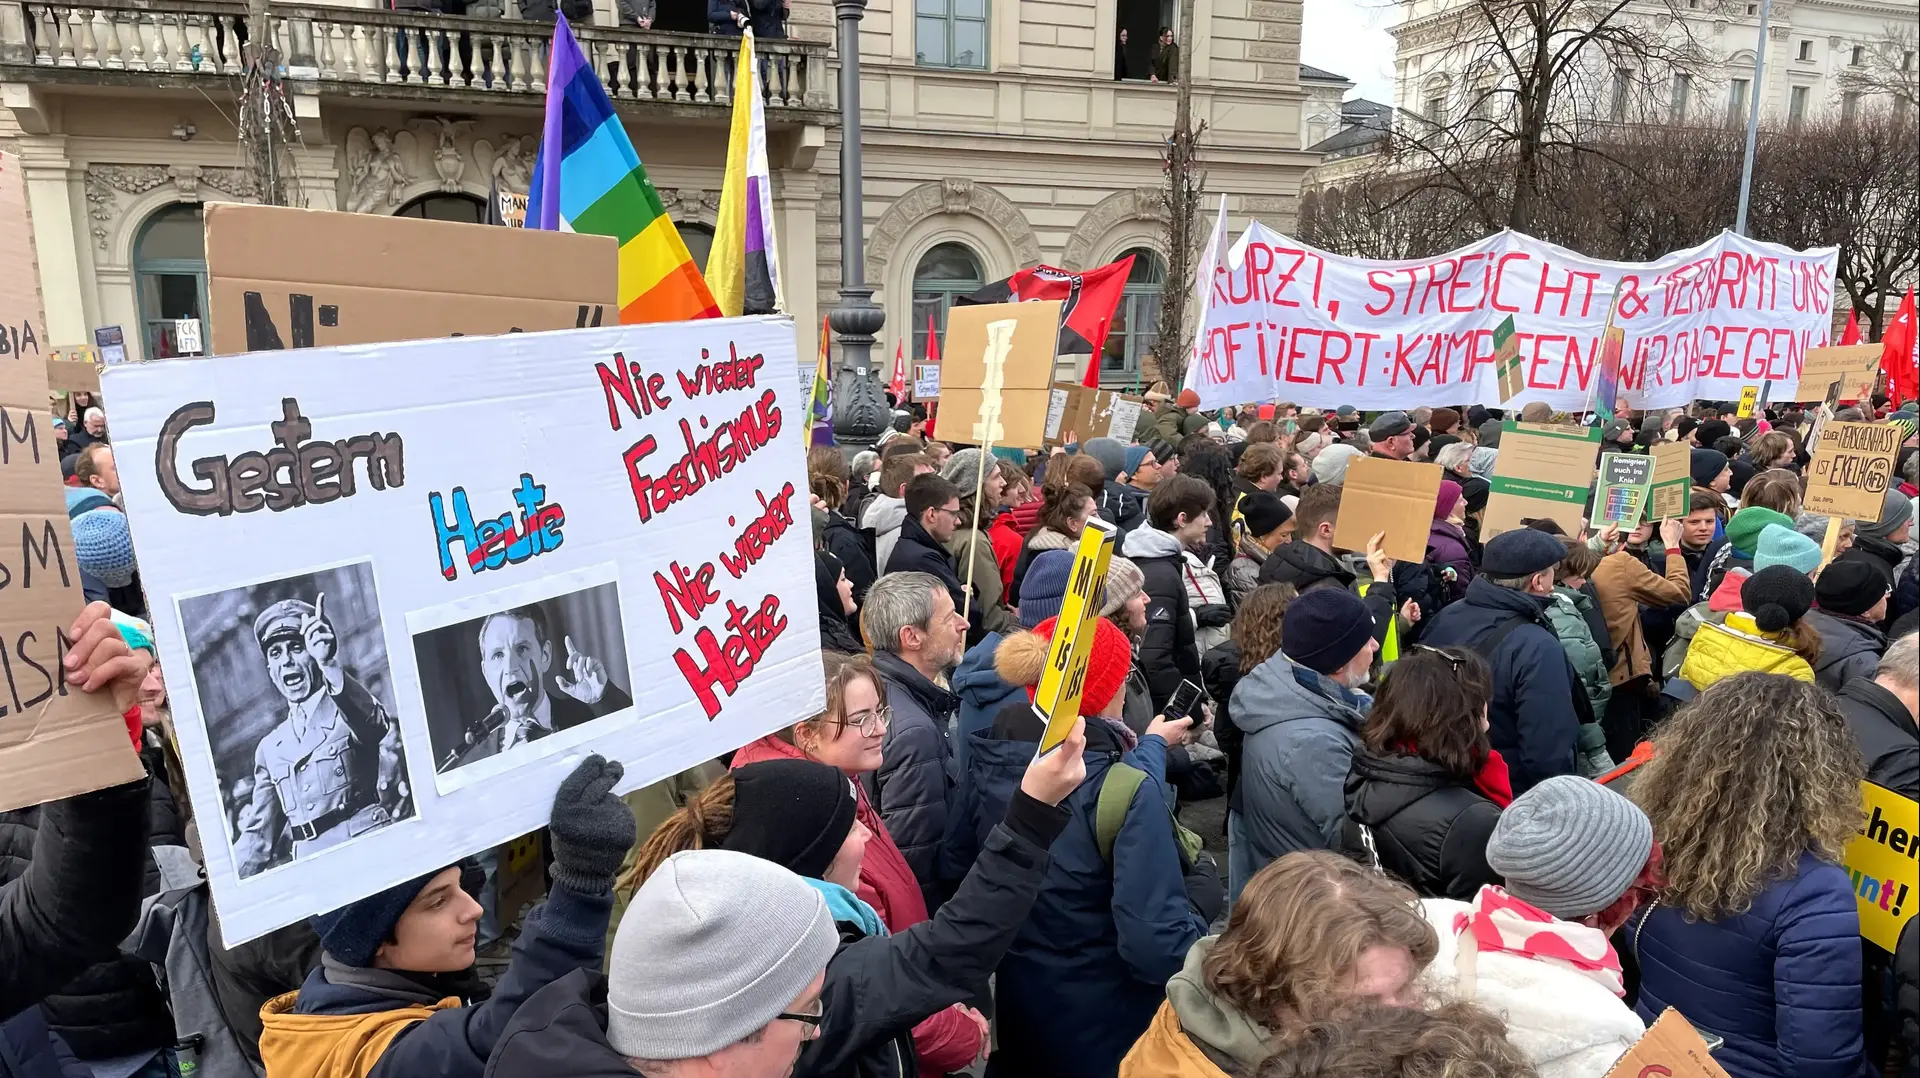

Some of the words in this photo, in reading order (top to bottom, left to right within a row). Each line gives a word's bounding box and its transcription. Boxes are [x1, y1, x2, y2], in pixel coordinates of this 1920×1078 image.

[1617, 275, 1650, 319] &
[1789, 260, 1830, 315] UNS
[176, 320, 196, 336] FCK
[178, 336, 198, 350] AFD
[594, 351, 673, 431] Nie
[676, 341, 764, 400] wieder
[155, 397, 405, 517] Gestern
[622, 388, 783, 524] Faschismus
[1613, 467, 1631, 475] euch
[1633, 468, 1644, 476] ins
[1815, 459, 1830, 476] IST
[1873, 461, 1886, 471] NO
[1618, 475, 1636, 484] Knie!
[1864, 470, 1887, 489] AFD
[428, 472, 566, 582] Heute
[652, 560, 721, 635] Nie
[719, 481, 795, 580] wieder
[672, 594, 788, 722] Hetze
